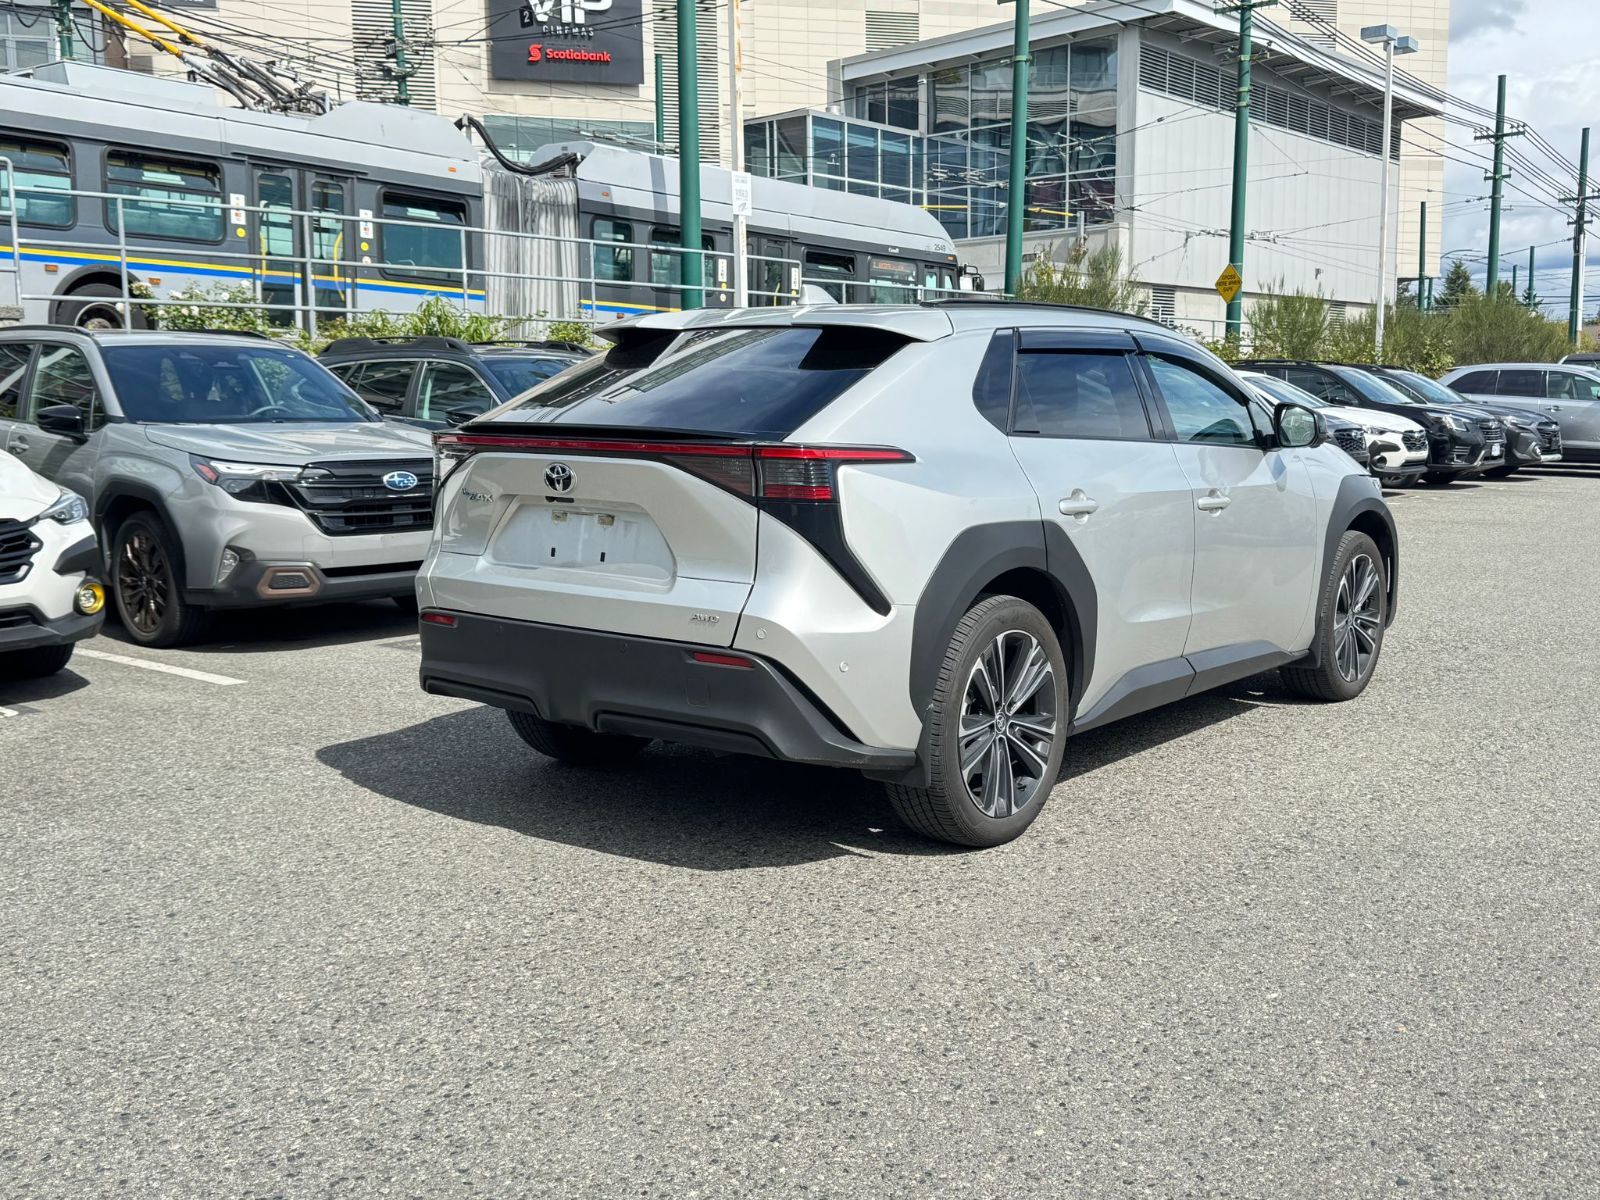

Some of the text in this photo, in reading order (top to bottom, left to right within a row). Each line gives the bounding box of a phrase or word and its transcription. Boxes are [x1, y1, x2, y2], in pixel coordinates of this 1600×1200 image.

[523, 11, 530, 22] 2
[527, 0, 613, 24] VIP
[542, 24, 595, 37] CINEMAS
[546, 48, 612, 62] Scotiabank
[691, 613, 719, 623] AWD
